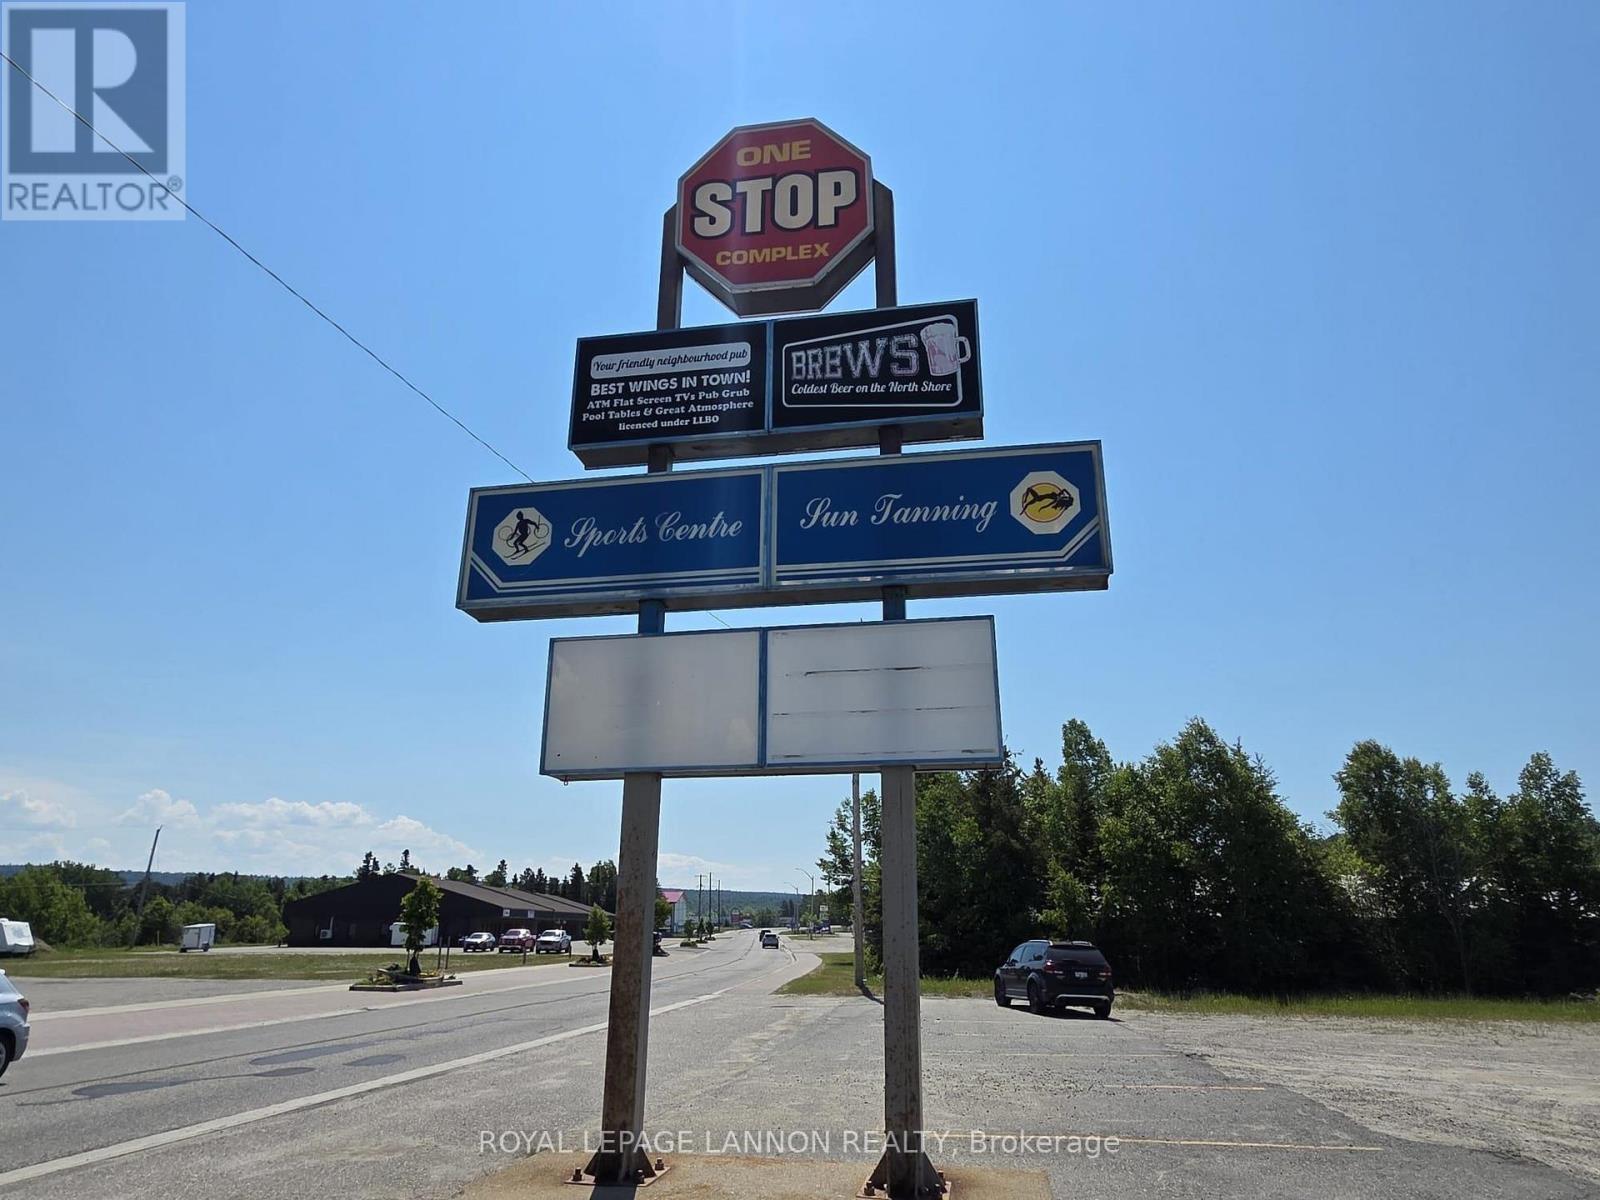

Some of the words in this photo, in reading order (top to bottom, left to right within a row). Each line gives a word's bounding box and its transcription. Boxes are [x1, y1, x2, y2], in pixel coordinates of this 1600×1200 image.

[736, 139, 812, 167] ONE
[692, 168, 858, 239] STOP
[715, 242, 831, 266] COMPLEX
[593, 360, 617, 373] Your
[616, 357, 655, 371] friendly
[656, 351, 728, 368] neighbourhood
[729, 349, 748, 362] pub
[791, 333, 920, 380] BREWS
[590, 382, 625, 396] BEST
[629, 378, 677, 393] WINGS
[682, 376, 697, 389] IN
[701, 370, 751, 387] TOWN!
[791, 383, 828, 395] Coldest
[830, 382, 854, 394] Beer
[856, 383, 869, 393] on
[870, 382, 887, 393] the
[888, 381, 919, 393] North
[921, 381, 952, 392] Shore
[582, 412, 605, 421] Pool
[608, 409, 641, 419] Tables
[643, 407, 653, 416] &
[655, 405, 685, 415] Great
[688, 400, 754, 413] Atmosphere
[586, 400, 611, 410] ATM
[613, 398, 634, 407] Flat
[637, 396, 672, 405] Screen
[674, 393, 696, 402] TVs
[698, 391, 719, 400] Pub
[721, 388, 750, 398] Grub
[618, 420, 658, 431] licenced
[660, 417, 690, 428] under
[692, 415, 720, 425] LLBO
[799, 497, 859, 529] Sun
[870, 493, 999, 533] Tanning
[564, 516, 649, 558] Sports
[655, 511, 743, 541] Centre
